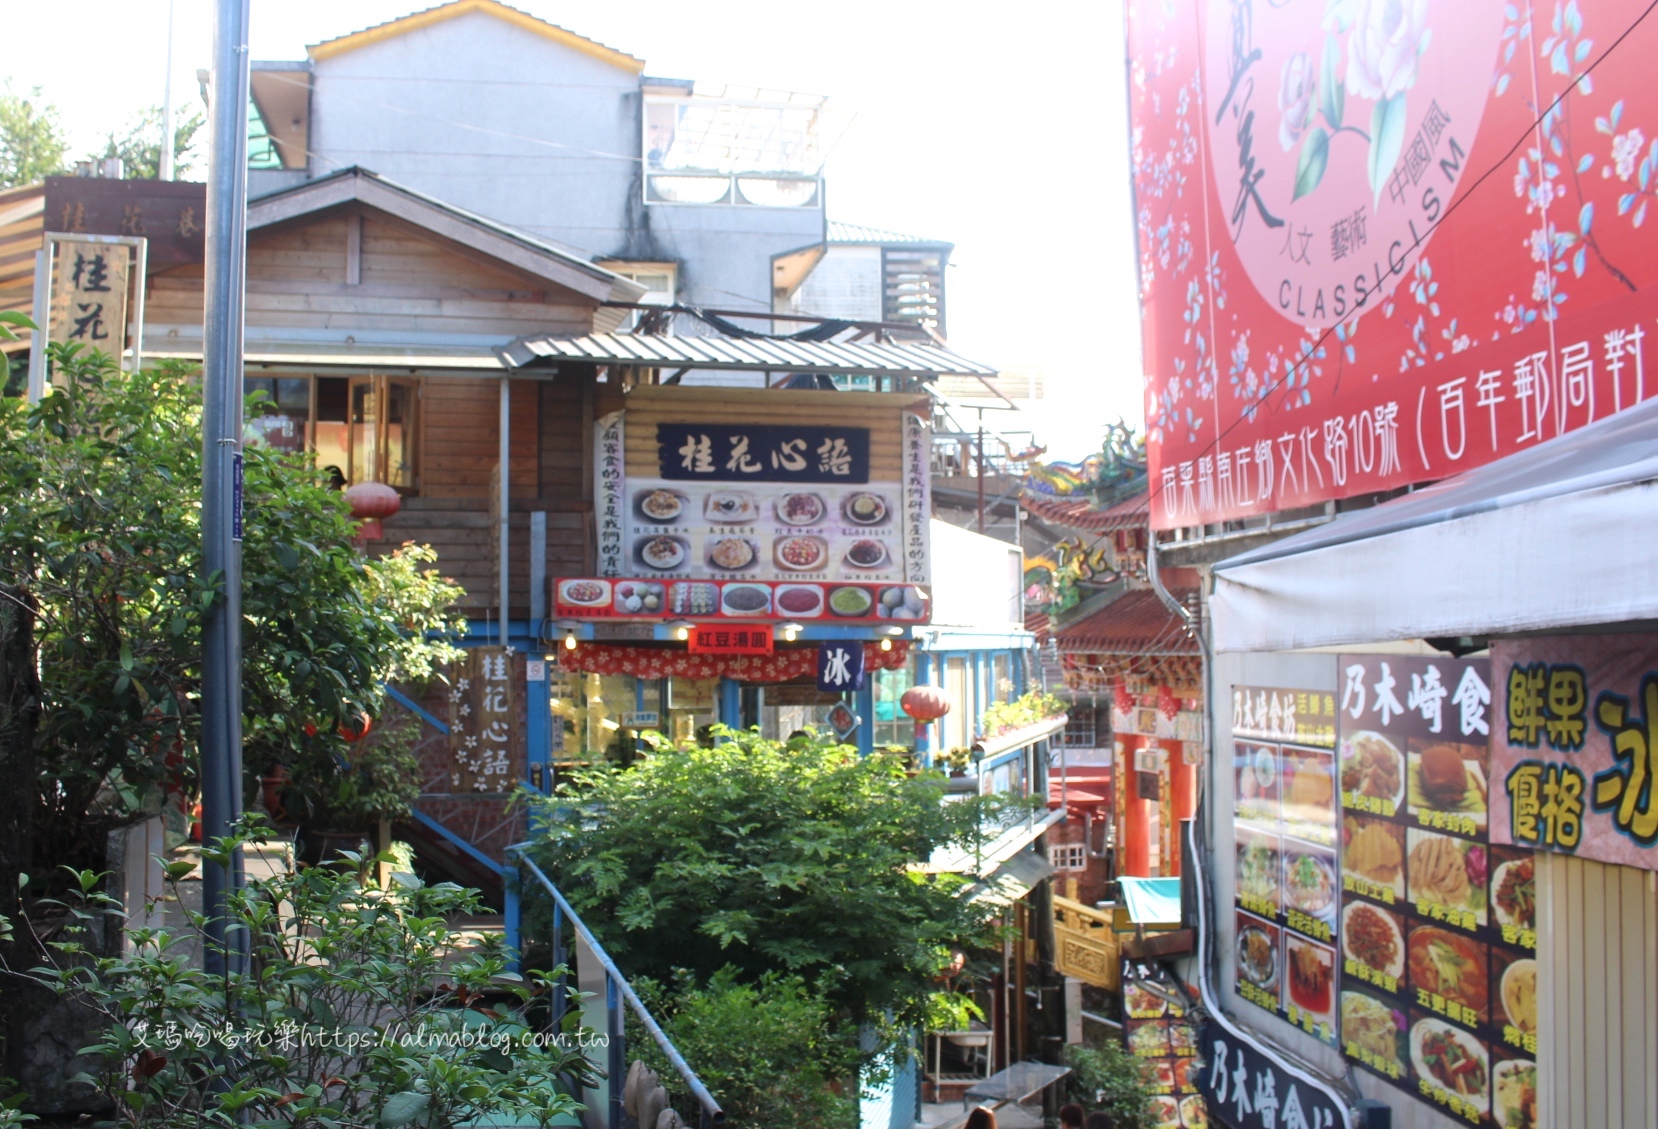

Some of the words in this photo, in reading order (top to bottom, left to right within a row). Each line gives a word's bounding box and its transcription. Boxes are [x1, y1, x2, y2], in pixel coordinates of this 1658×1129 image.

[1279, 222, 1314, 266] 人文
[1330, 206, 1367, 262] 藝術
[1389, 98, 1452, 206] 中國風
[1279, 136, 1466, 320] CLASSICISM
[678, 434, 852, 476] 桂花心語
[697, 632, 767, 648] 紅豆湯圓
[823, 648, 851, 687] 冰
[481, 653, 509, 776] 桂花心語
[1233, 689, 1296, 741] 乃木崎食坊
[1341, 661, 1491, 737] 乃木崎食
[1508, 667, 1584, 746] 鮮果
[1507, 765, 1582, 848] 優格
